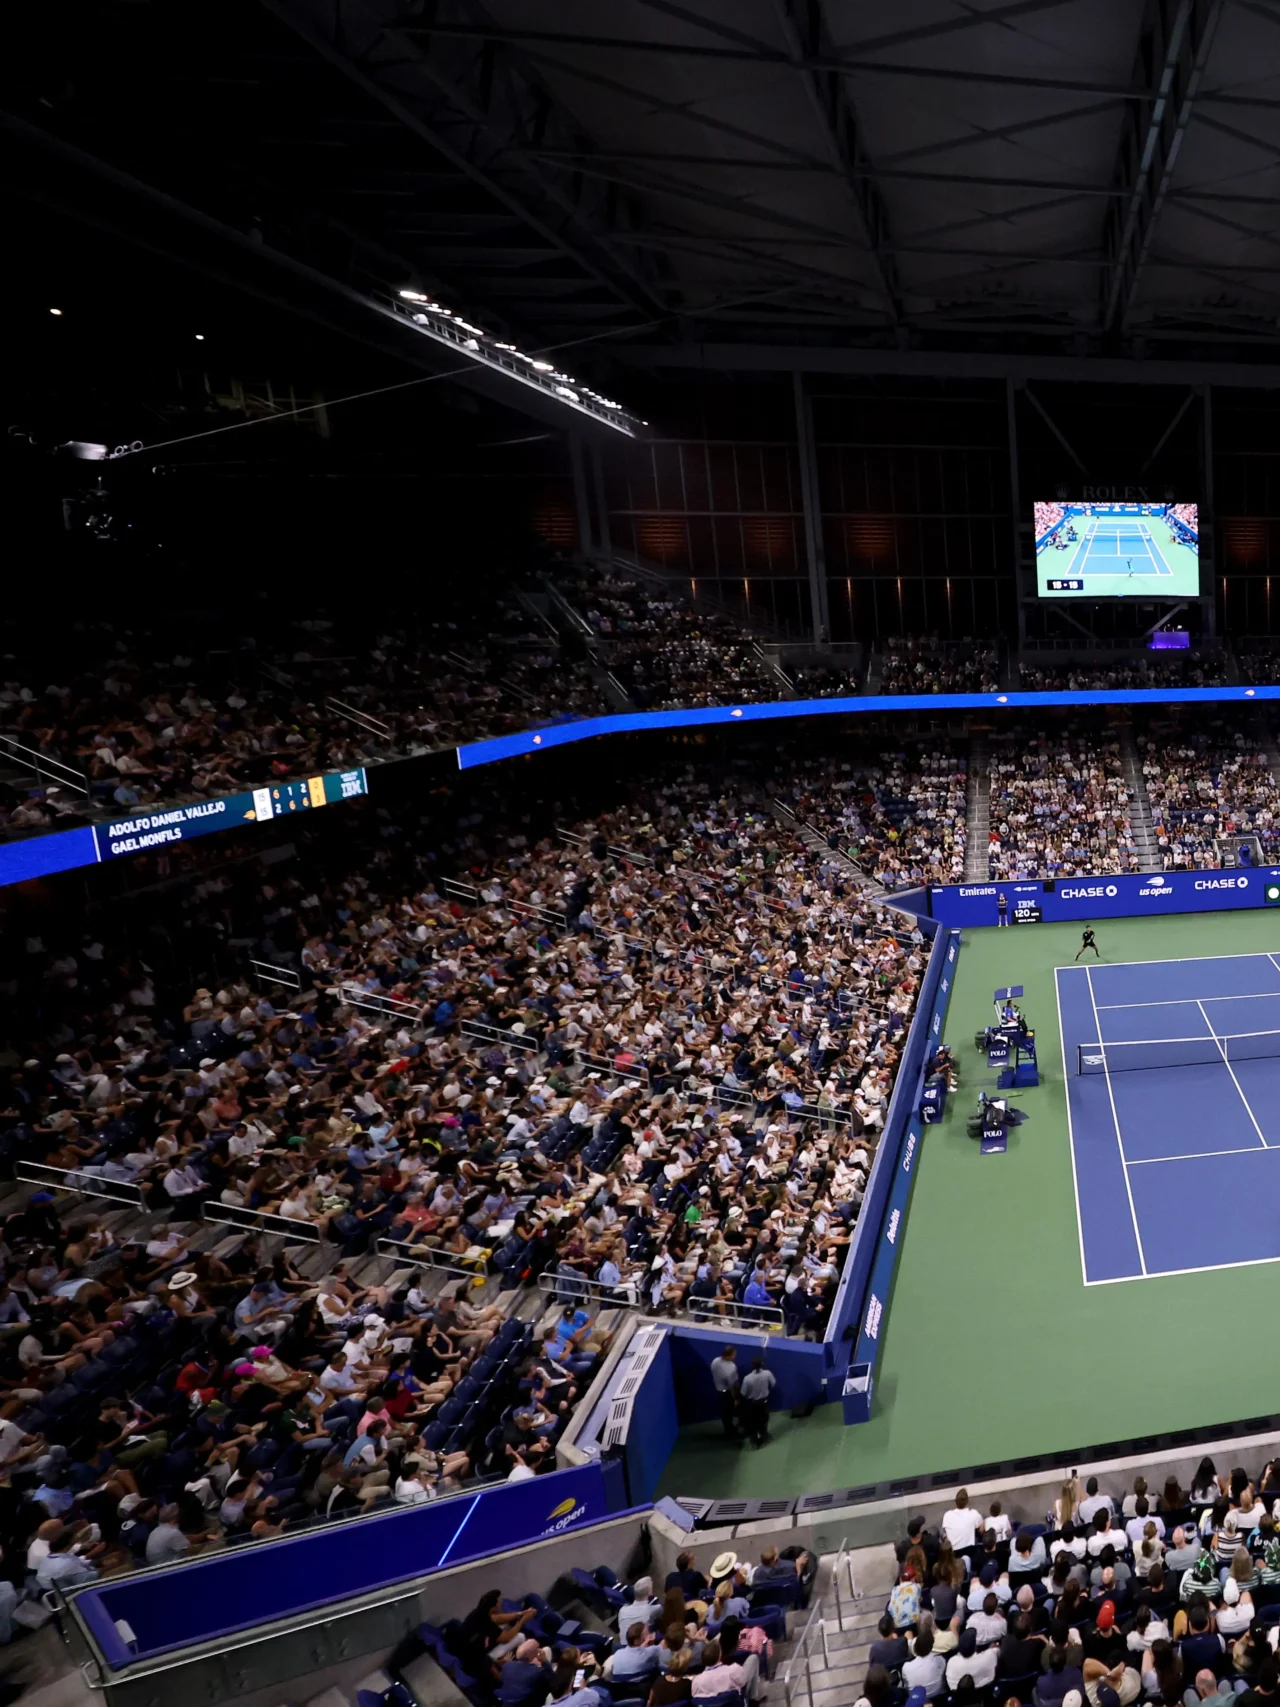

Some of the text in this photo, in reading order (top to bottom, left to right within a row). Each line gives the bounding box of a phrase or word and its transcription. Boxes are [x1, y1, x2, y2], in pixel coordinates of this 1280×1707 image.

[1082, 484, 1151, 500] ROLEX
[300, 783, 307, 793] 2
[341, 780, 363, 798] IBM
[273, 789, 280, 800] 6
[289, 800, 296, 810] 6
[302, 797, 309, 807] 6
[275, 803, 283, 814] 2
[109, 801, 226, 838] ADOLFO DANIEL VALLEJO
[111, 828, 182, 854] GAEL MONFILS
[1194, 878, 1236, 890] CHASE
[959, 886, 997, 897] Emirates
[1061, 887, 1105, 899] CHASE
[1139, 887, 1173, 897] us open
[1017, 899, 1037, 909] IBM
[1014, 909, 1031, 918] 120
[983, 1129, 1003, 1138] POLO
[902, 1132, 917, 1172] CHUBB
[555, 1505, 586, 1529] open
